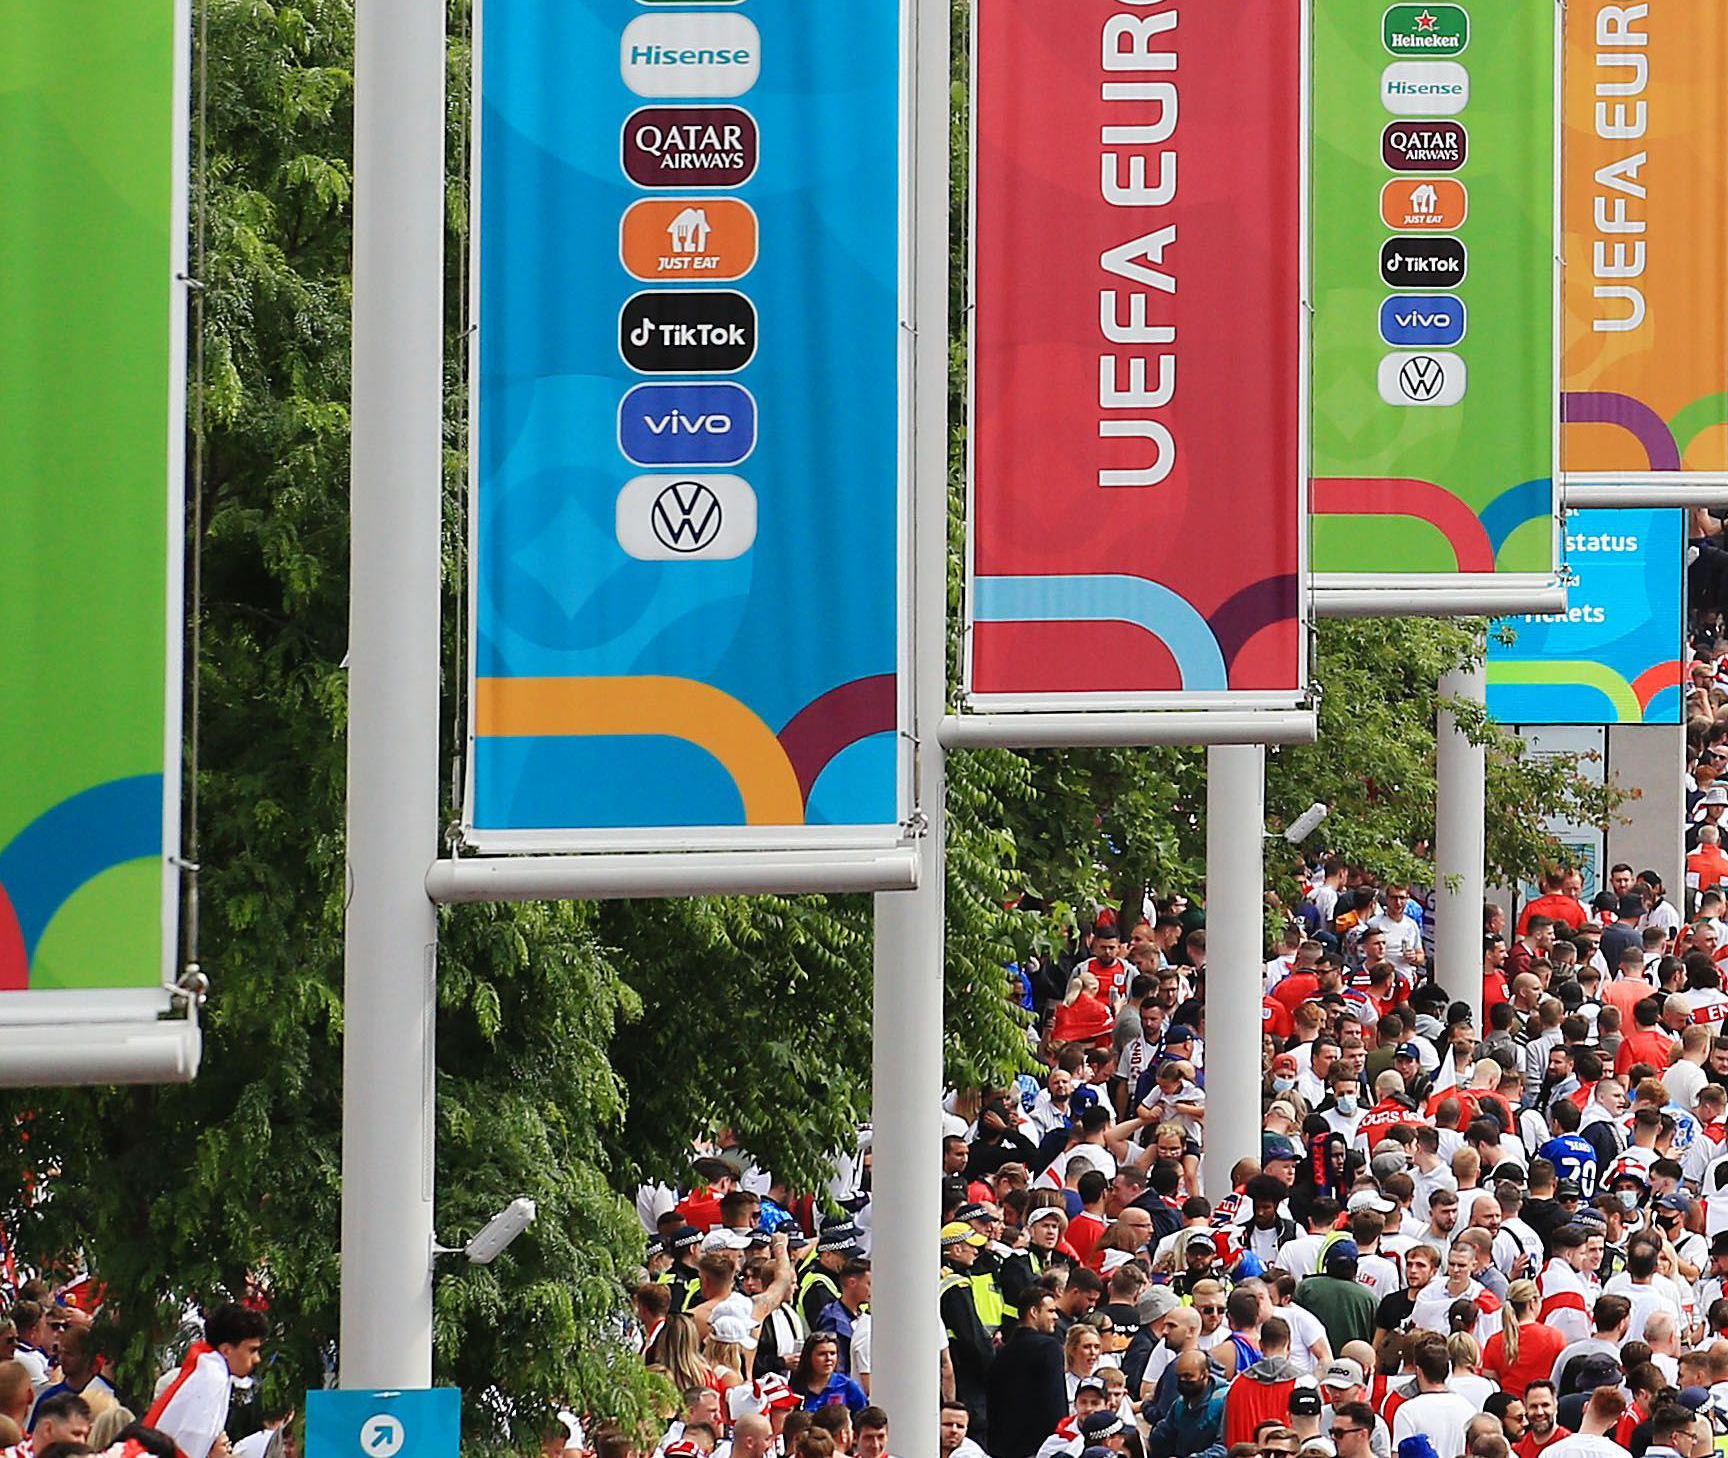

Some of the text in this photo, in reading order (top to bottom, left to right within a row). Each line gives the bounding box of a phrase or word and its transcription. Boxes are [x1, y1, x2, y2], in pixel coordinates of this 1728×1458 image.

[1391, 33, 1457, 47] Heineken
[630, 44, 750, 67] Hisense
[1388, 82, 1462, 95] Hisense
[635, 125, 743, 155] QATAR
[1390, 131, 1457, 151] QATAR
[660, 150, 745, 170] AIRWAYS
[1406, 149, 1458, 161] AIRWAYS
[1404, 215, 1443, 224] JUST EAT
[1593, 151, 1648, 332] UEFA
[657, 256, 720, 270] JUST EAT
[1405, 257, 1459, 272] TikTok
[1395, 311, 1451, 328] vivo
[658, 323, 746, 347] TikTok
[1099, 224, 1177, 488] UEFA
[644, 409, 731, 434] vivo
[1566, 532, 1638, 552] status
